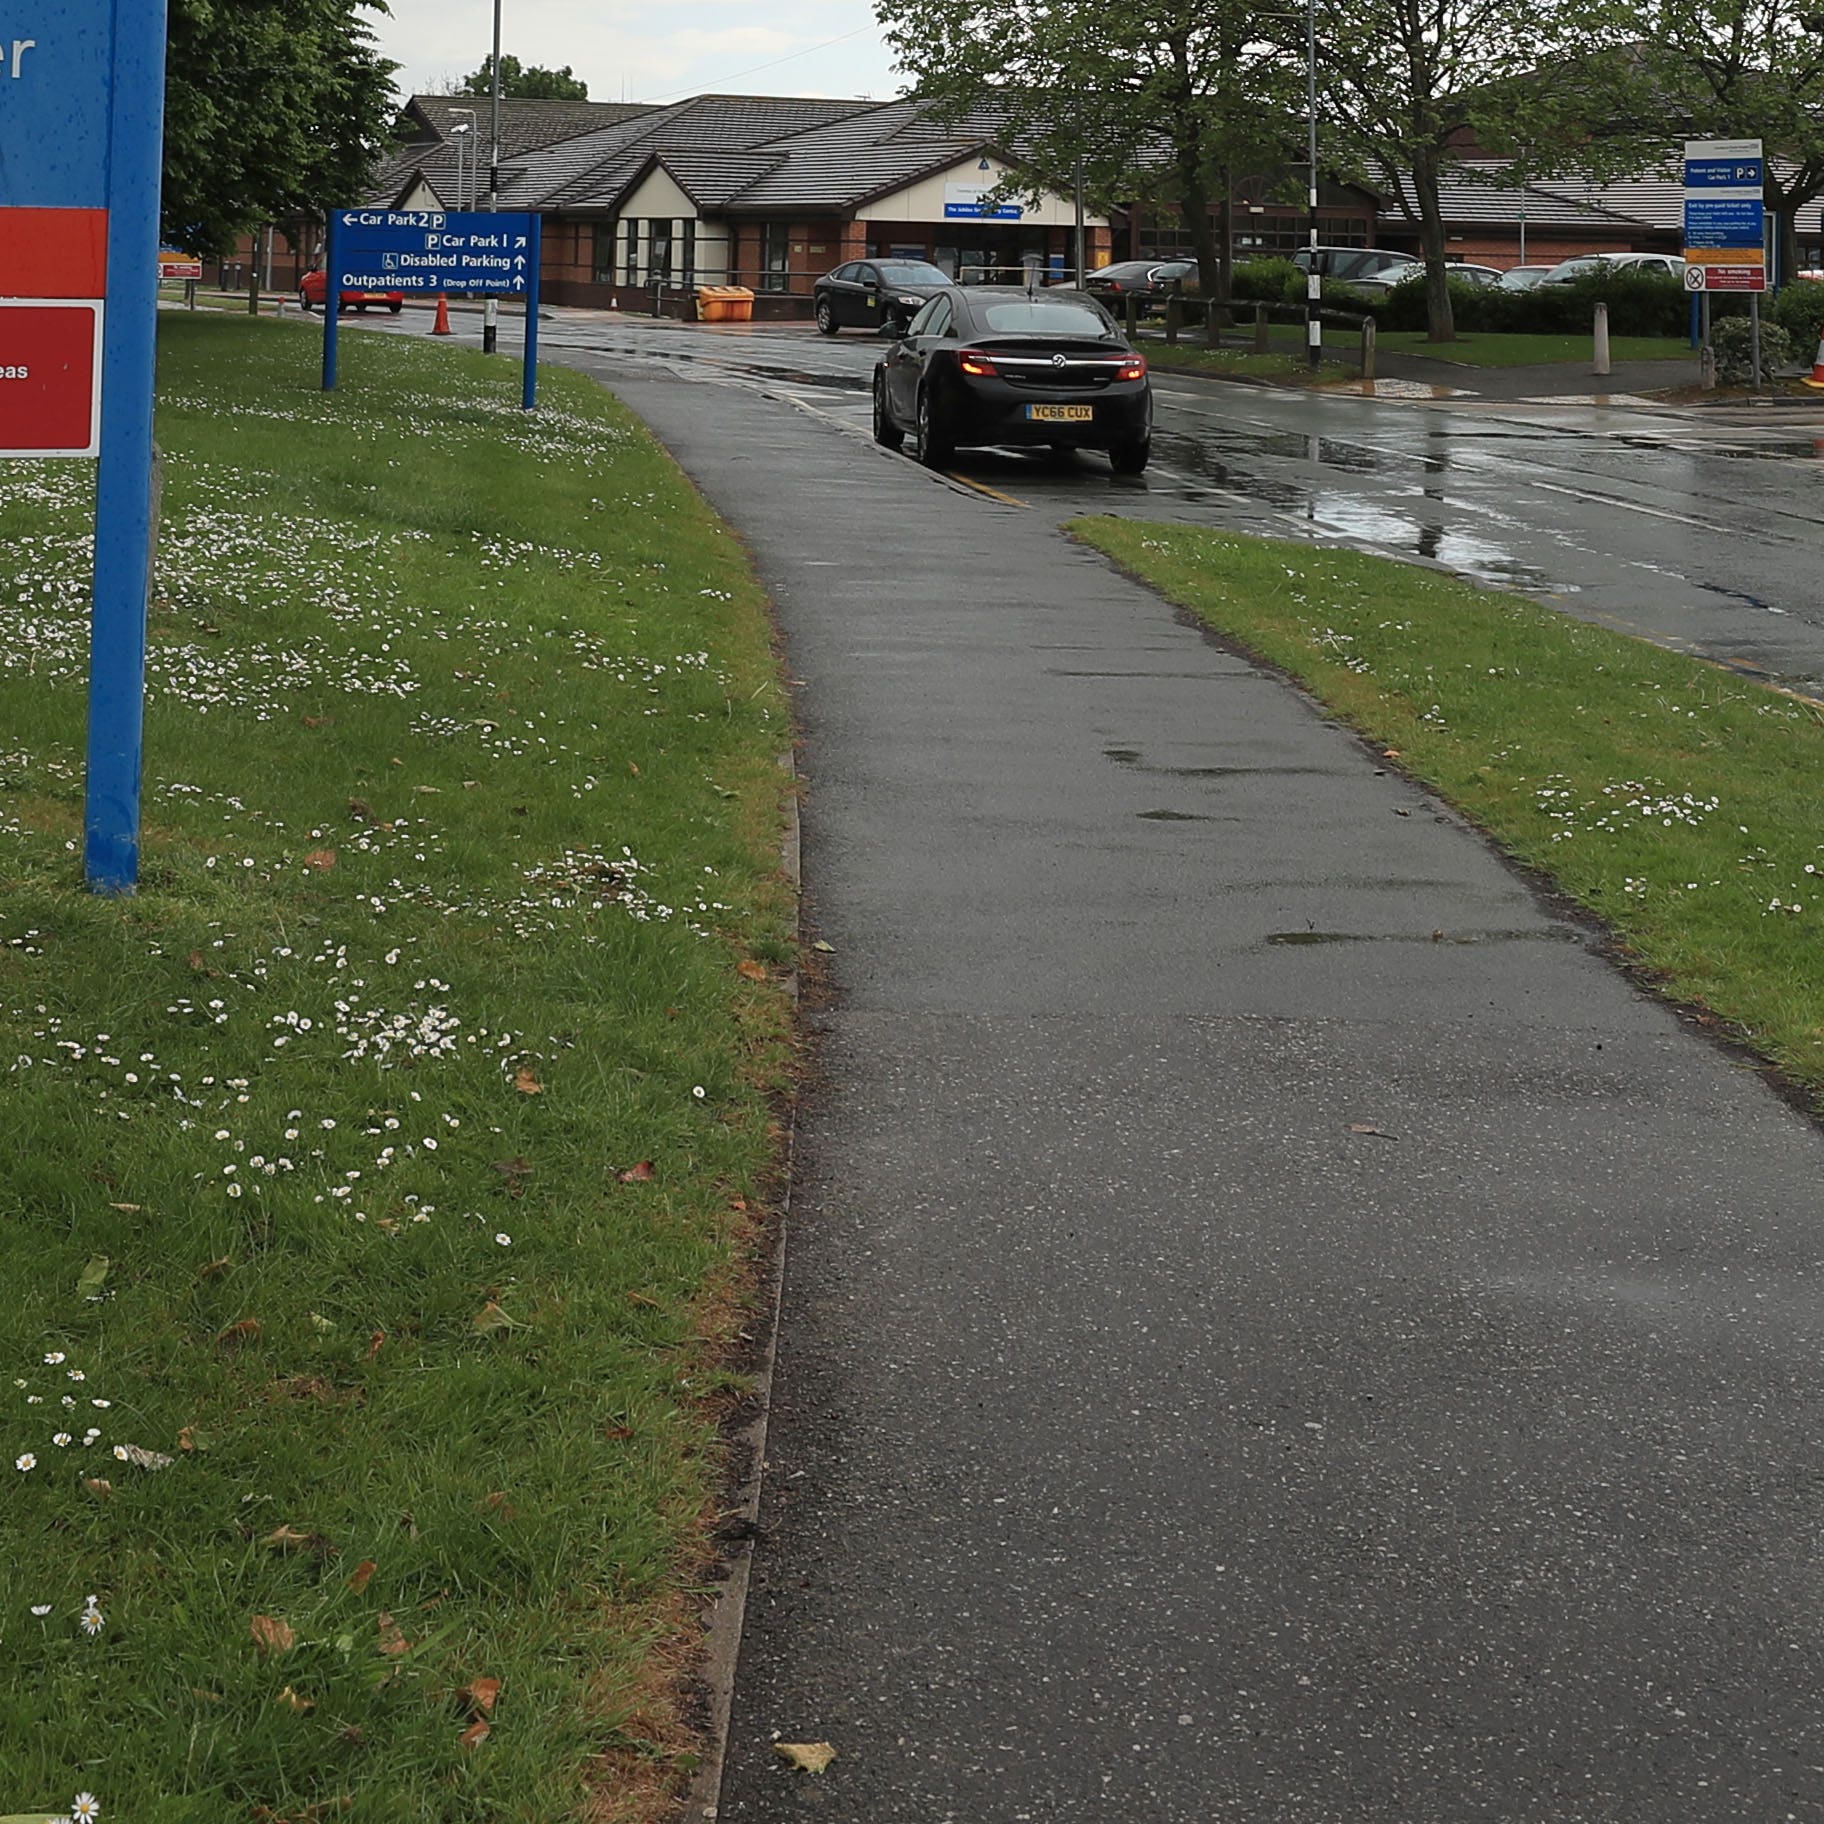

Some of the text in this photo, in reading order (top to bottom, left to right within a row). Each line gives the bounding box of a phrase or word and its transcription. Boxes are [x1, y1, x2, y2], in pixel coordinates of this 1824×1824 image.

[359, 212, 443, 228] Car Park 2 P
[427, 235, 438, 249] P
[442, 235, 465, 247] Car
[470, 235, 499, 247] Park
[400, 253, 510, 270] Disabled Parking
[342, 274, 510, 288] Outpatients 3 (Drop Off Point)
[1034, 405, 1091, 418] YC66 CUX
